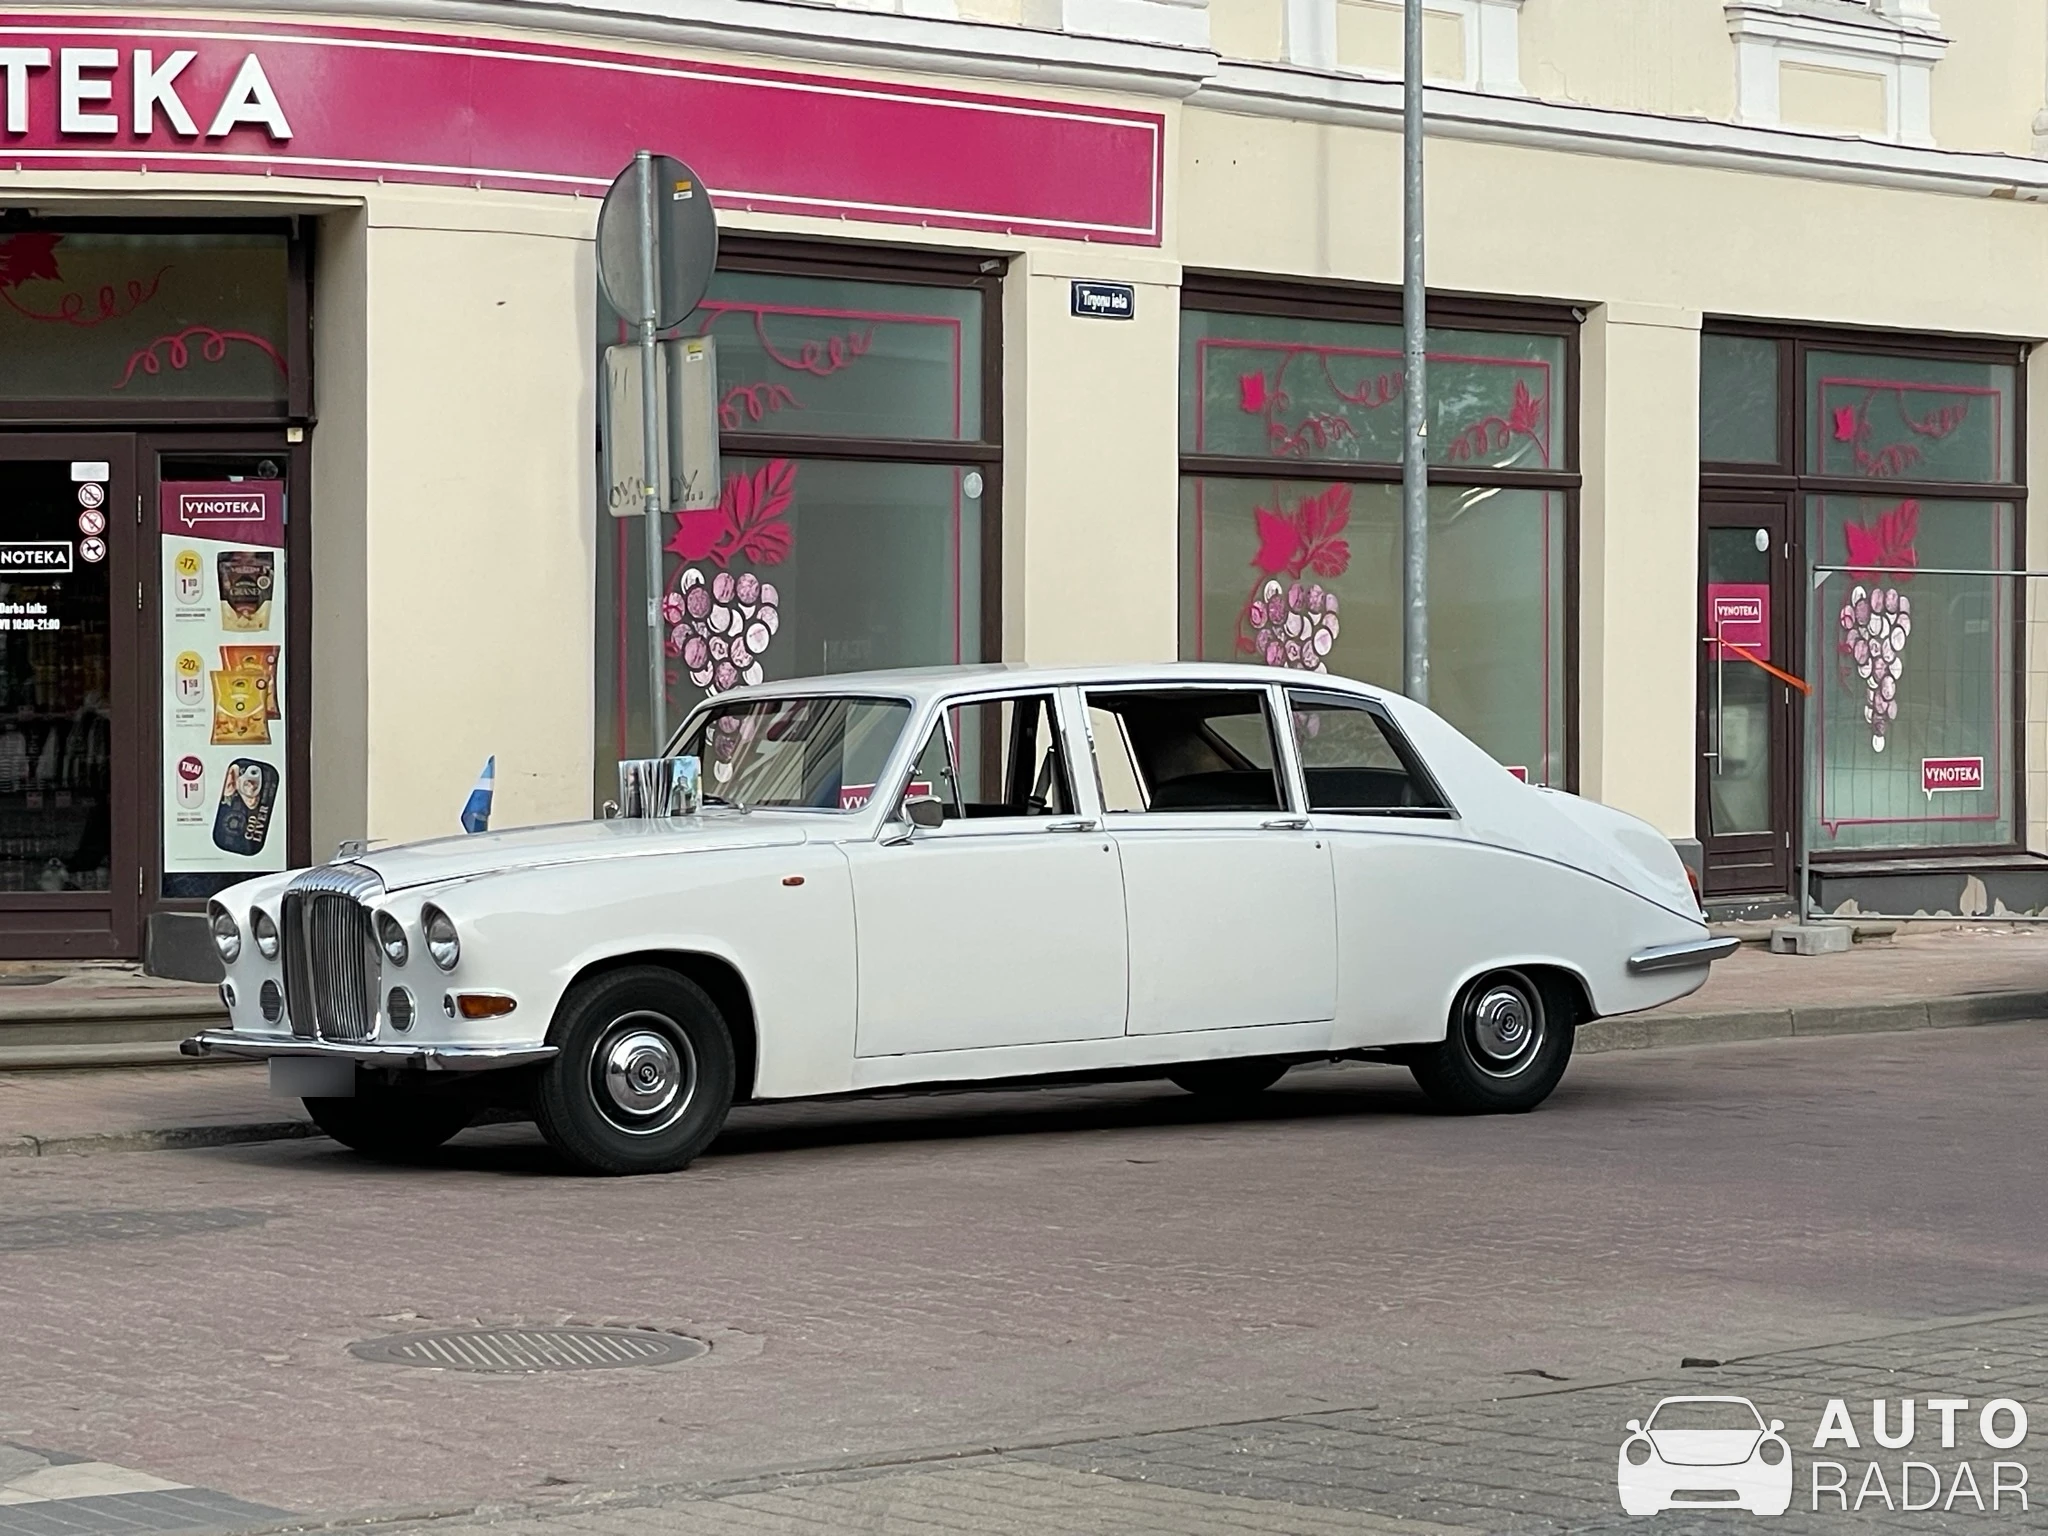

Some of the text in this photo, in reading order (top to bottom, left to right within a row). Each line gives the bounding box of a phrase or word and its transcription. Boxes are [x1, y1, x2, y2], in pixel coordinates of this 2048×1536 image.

[0, 47, 294, 139] TEKA
[1111, 292, 1128, 309] iela
[185, 502, 260, 514] VYNOTEKA
[1, 550, 67, 564] NOTEKA
[26, 602, 48, 614] laiks
[1717, 606, 1759, 616] VYNOTEKA
[1925, 767, 1980, 782] VYNOTEKA
[244, 815, 257, 840] COD
[252, 805, 269, 843] LIVER
